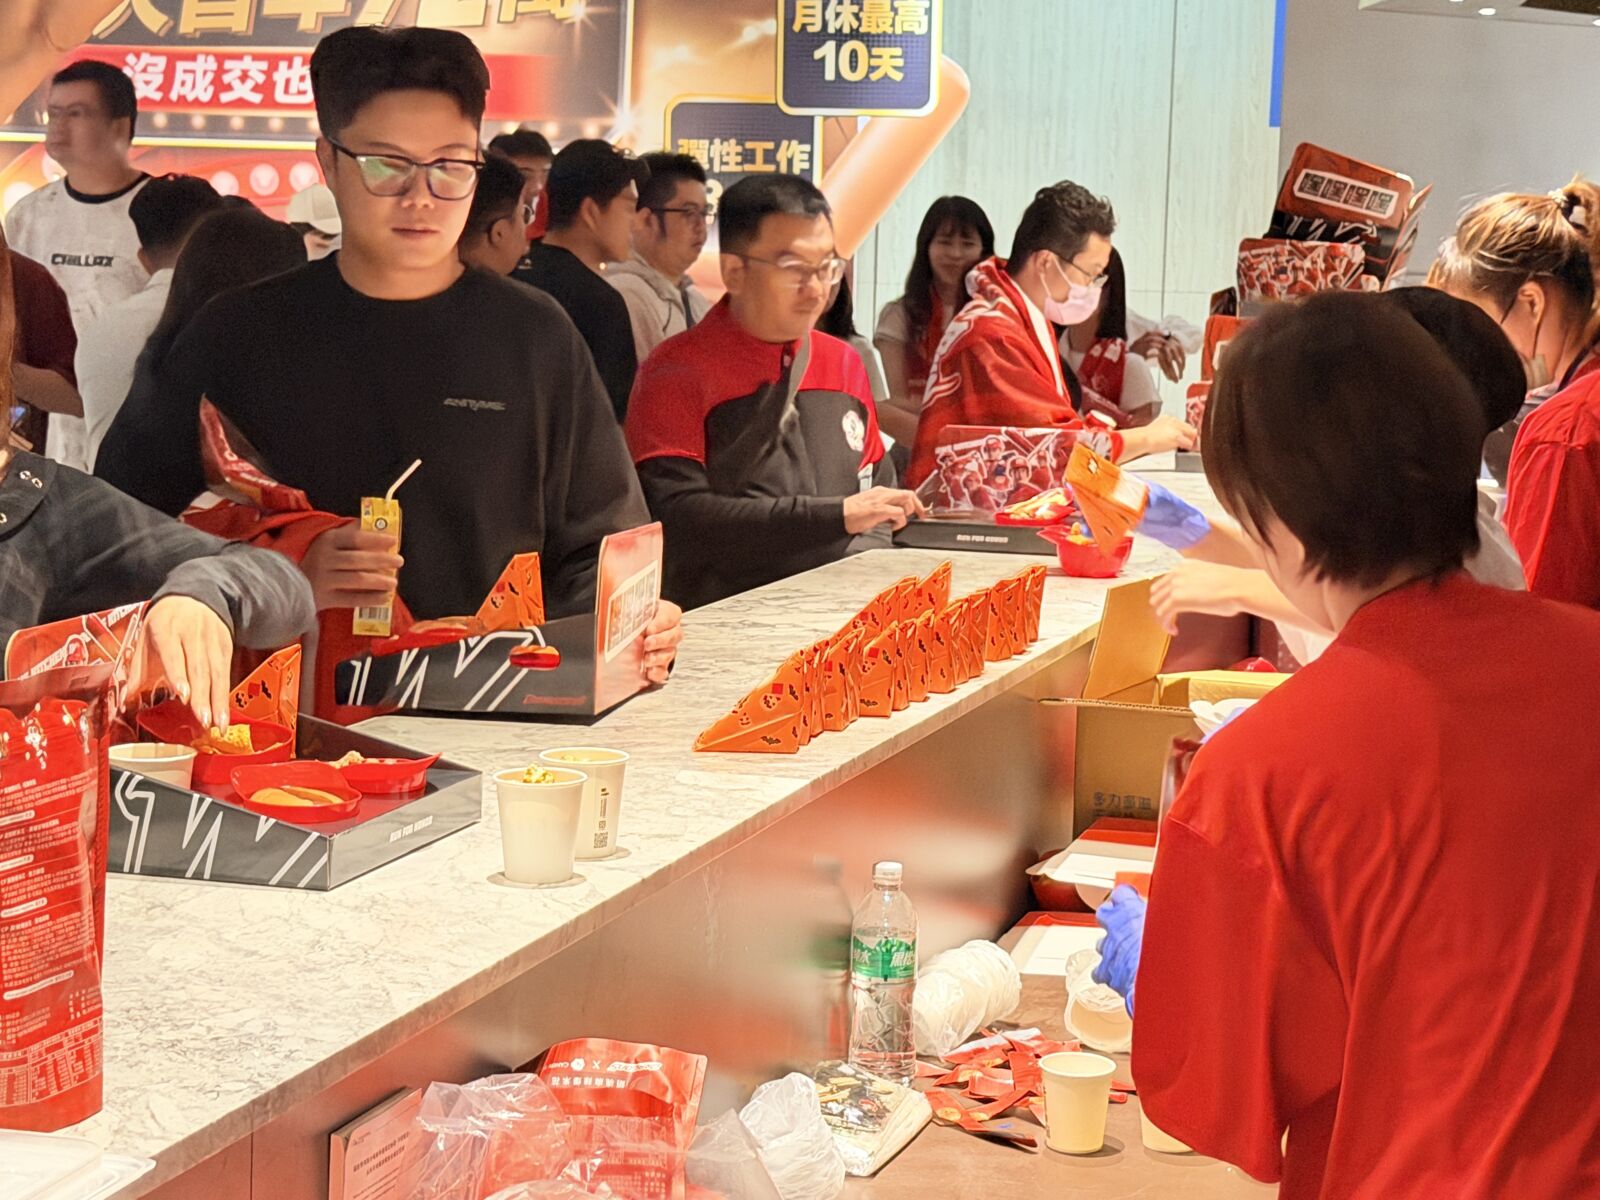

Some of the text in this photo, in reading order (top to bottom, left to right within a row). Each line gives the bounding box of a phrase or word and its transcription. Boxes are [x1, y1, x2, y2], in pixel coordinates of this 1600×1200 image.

[792, 0, 930, 35] 月休最高
[122, 52, 312, 105] 沒成交也
[813, 40, 905, 82] 10天
